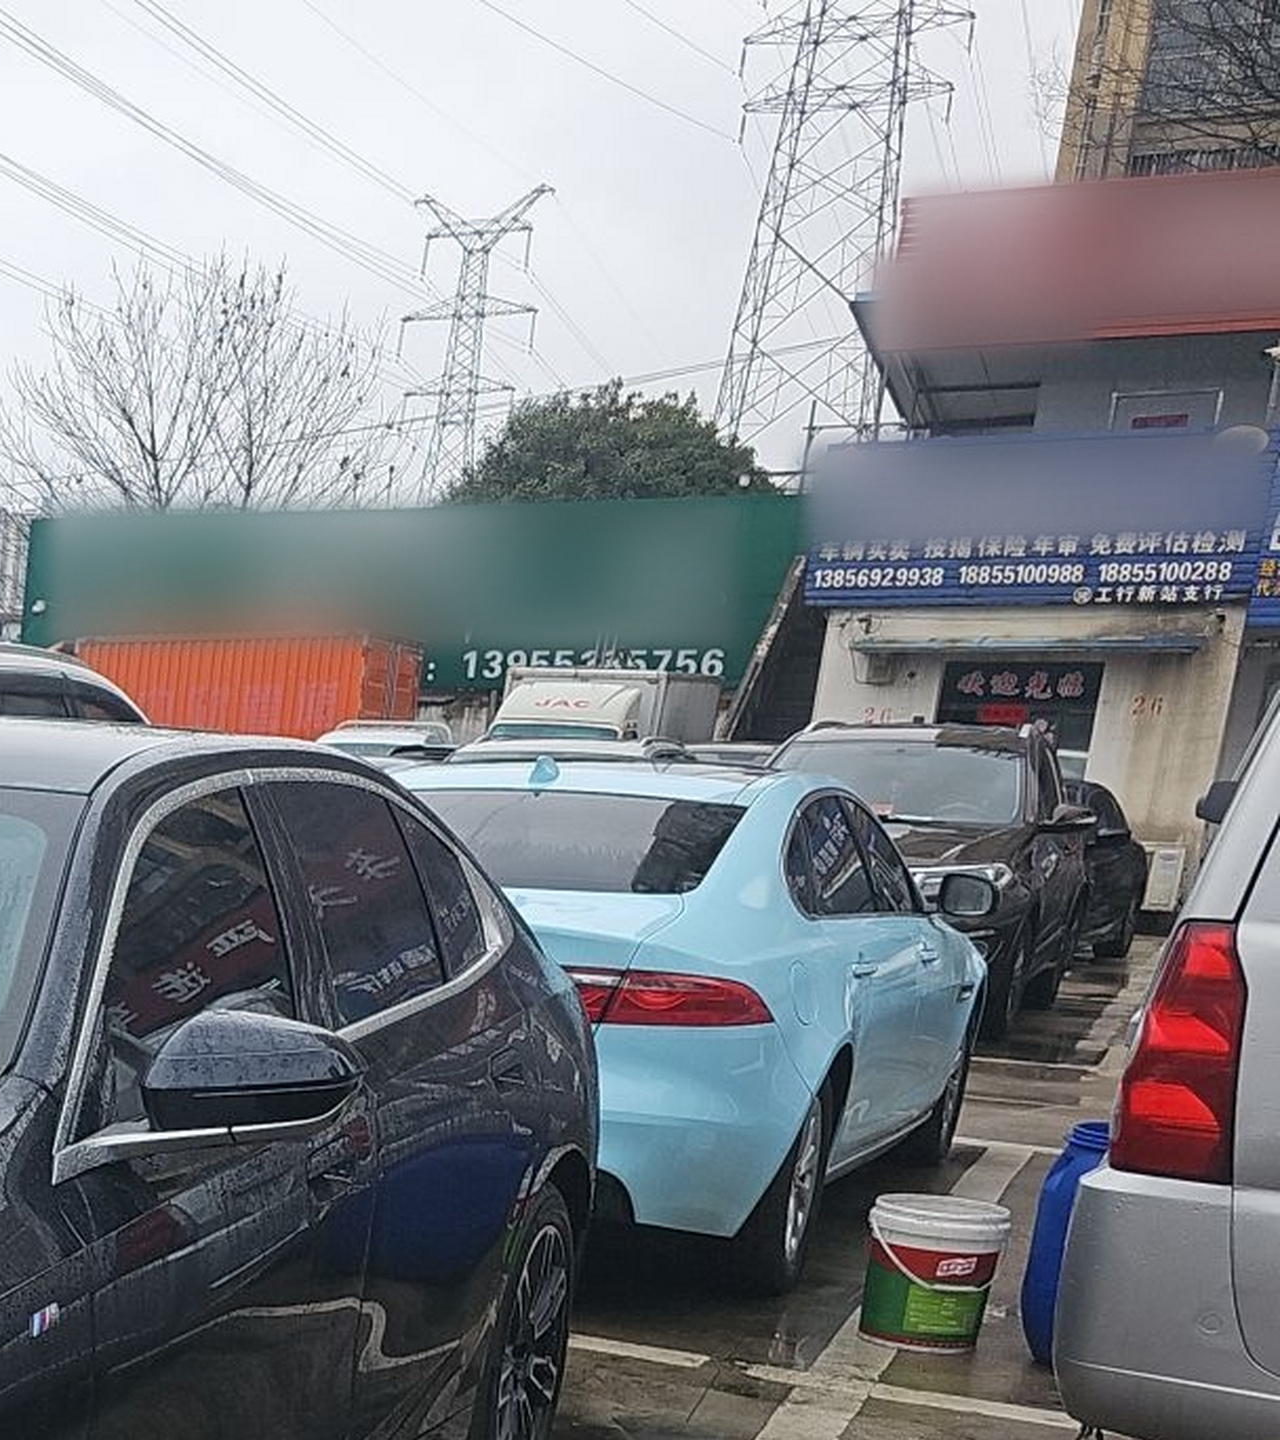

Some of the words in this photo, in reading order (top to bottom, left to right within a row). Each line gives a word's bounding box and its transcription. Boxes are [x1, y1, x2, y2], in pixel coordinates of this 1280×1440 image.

[813, 566, 945, 589] 13856929938
[958, 563, 1085, 586] 18855100988
[1097, 560, 1233, 584] 18855100288
[957, 671, 1086, 699] 欢迎光临
[535, 697, 591, 709] JAC
